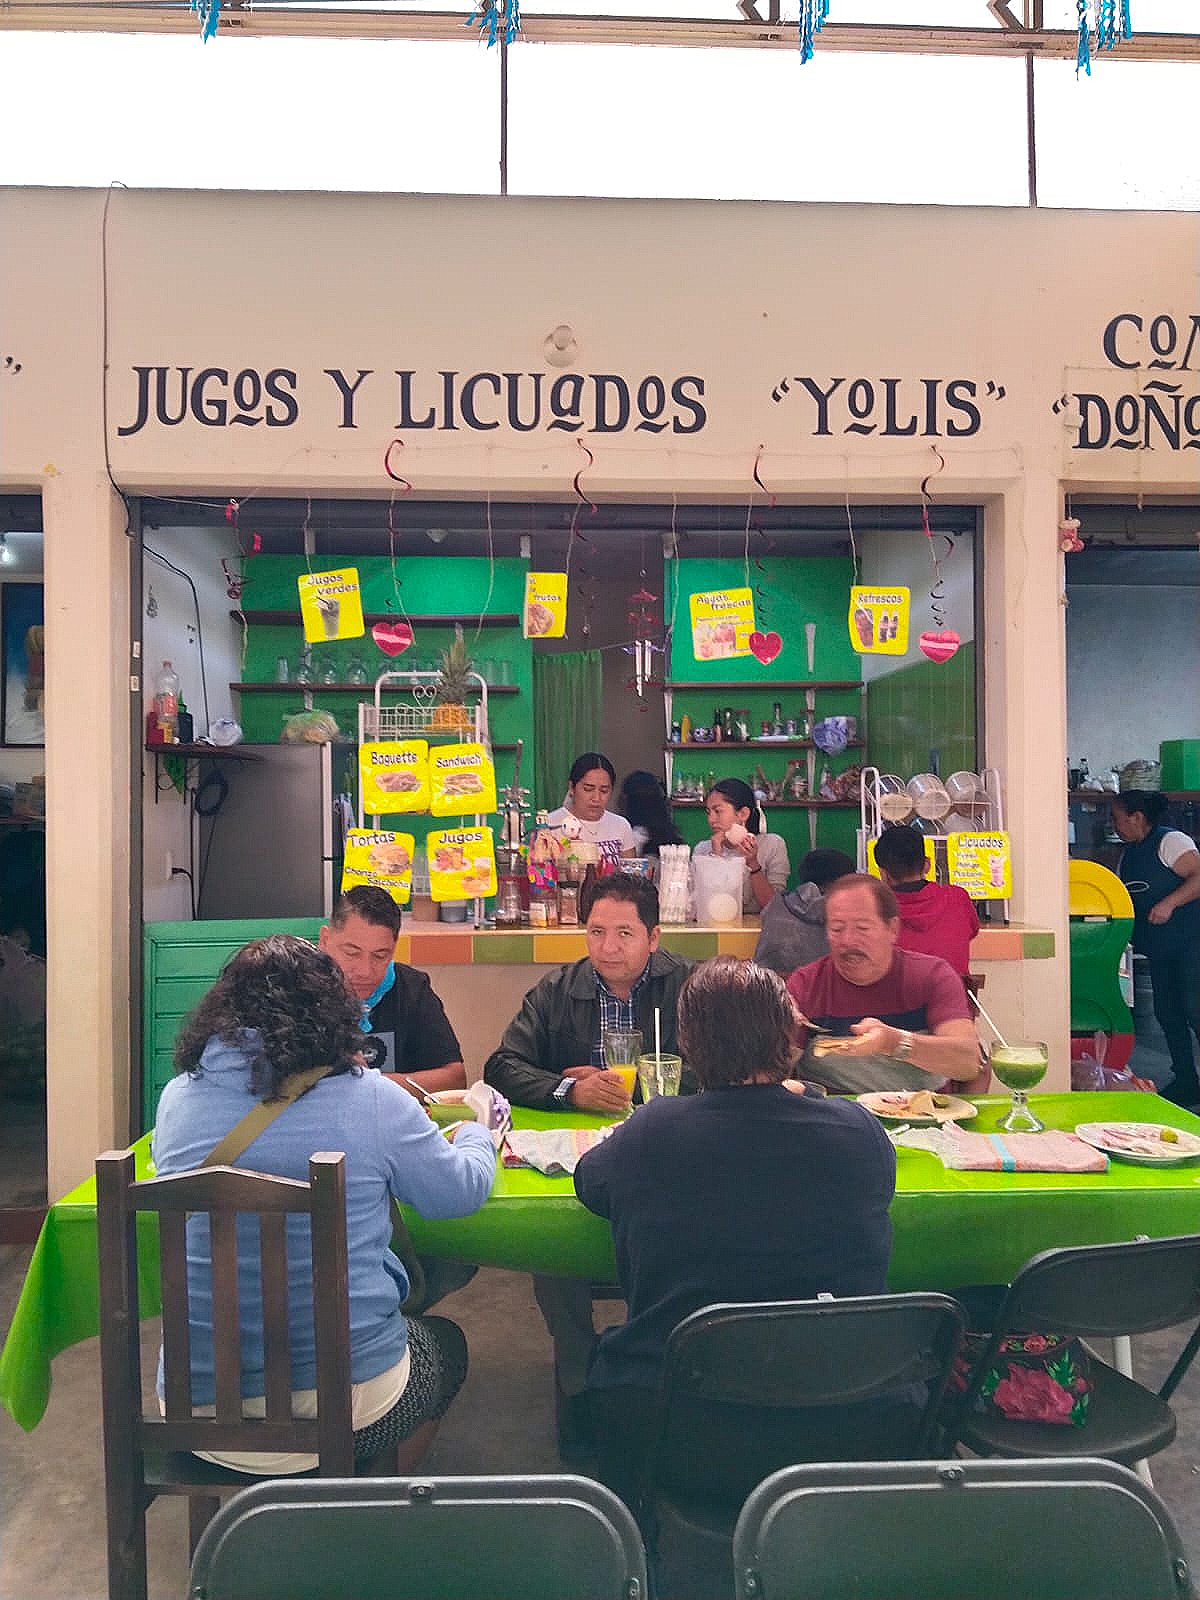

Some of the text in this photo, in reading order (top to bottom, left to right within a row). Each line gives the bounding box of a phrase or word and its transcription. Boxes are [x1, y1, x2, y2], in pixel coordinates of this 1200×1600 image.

[117, 366, 299, 437] JUGOS
[323, 368, 374, 429] Y
[371, 751, 418, 767] Baguette
[435, 753, 482, 768] Sandwich
[346, 832, 396, 848] Tortas
[438, 831, 483, 845] Jugos
[958, 835, 1004, 848] Licuados
